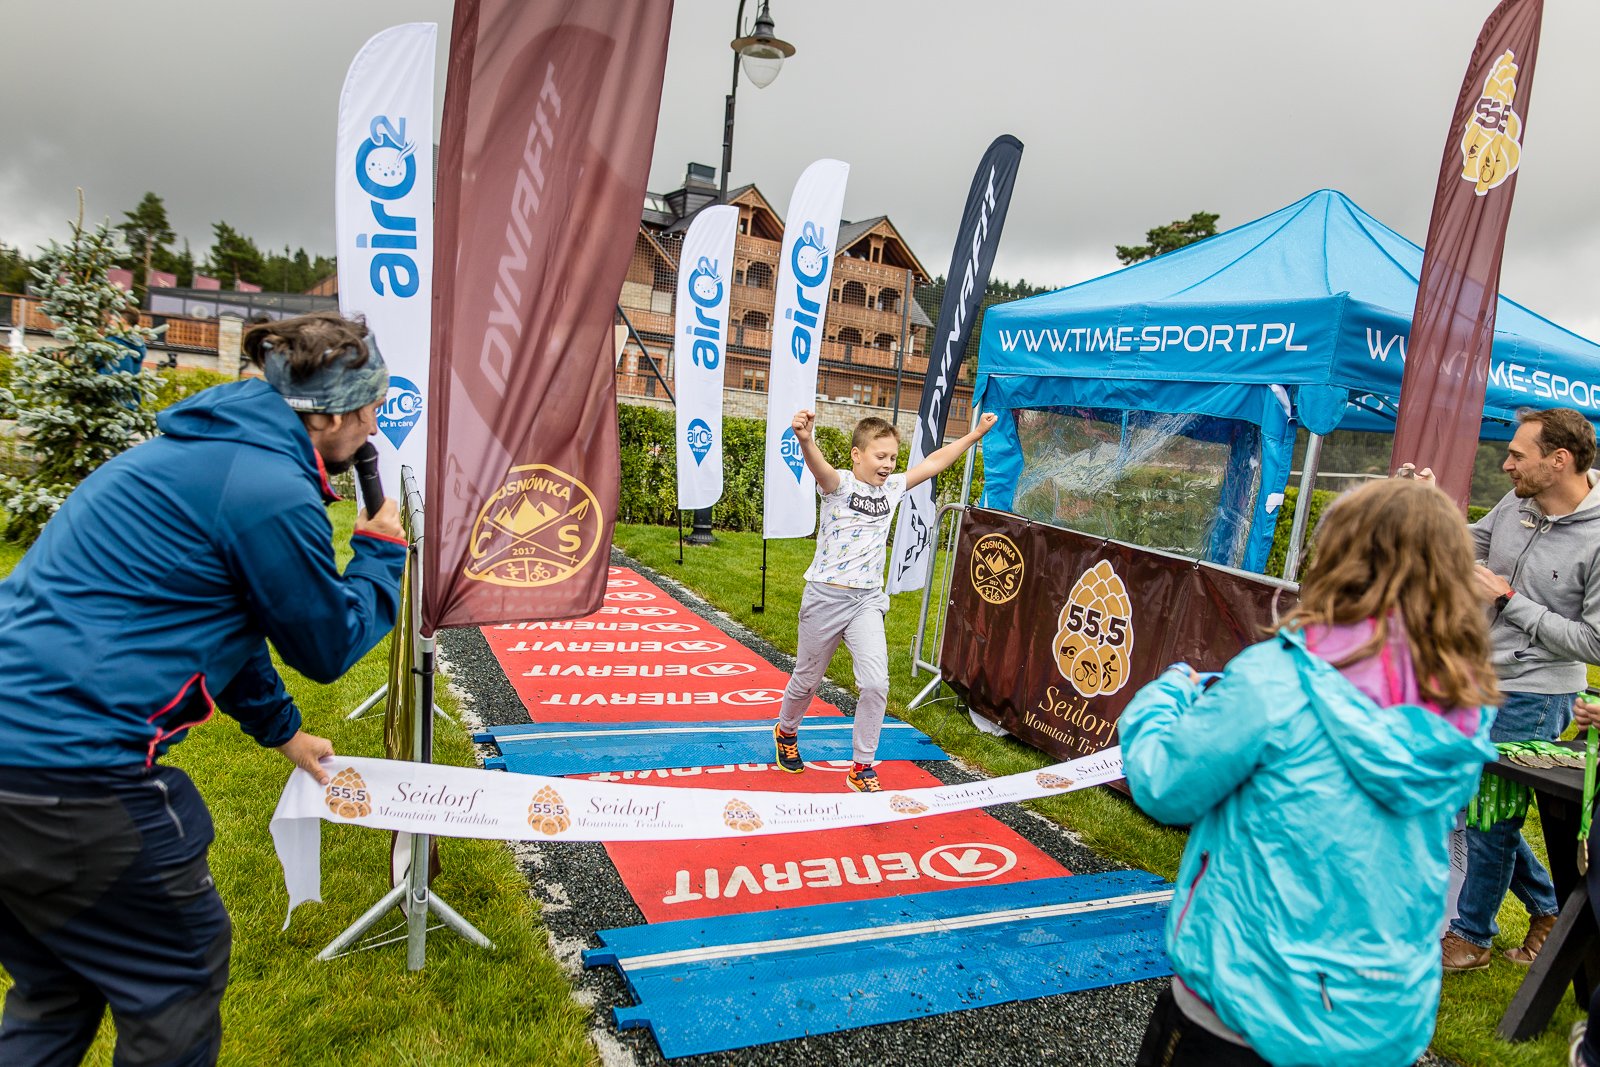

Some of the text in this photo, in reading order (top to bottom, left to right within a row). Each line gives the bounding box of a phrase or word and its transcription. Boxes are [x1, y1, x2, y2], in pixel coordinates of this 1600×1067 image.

[480, 61, 562, 399] DYNAFIT
[928, 164, 997, 446] DYNAFIT
[998, 322, 1308, 352] WWW.TIME-SPORT.PL
[474, 531, 493, 560] C
[512, 546, 536, 556] 2017
[557, 524, 583, 553] S
[975, 563, 986, 580] C
[1004, 573, 1016, 590] S
[1066, 604, 1128, 648] 55,5
[1022, 710, 1075, 747] Mountain
[1037, 685, 1121, 748] Seidorf
[1075, 759, 1123, 775] Seidor
[331, 786, 366, 802] 55,5
[391, 781, 484, 814] Seidorf
[377, 805, 499, 826] Mountain Triathlon
[533, 803, 565, 816] 55,5
[576, 817, 629, 828] Mountain
[586, 796, 666, 822] Seidorf
[774, 802, 843, 816] Seidorf
[662, 851, 922, 905] ENERVIT
